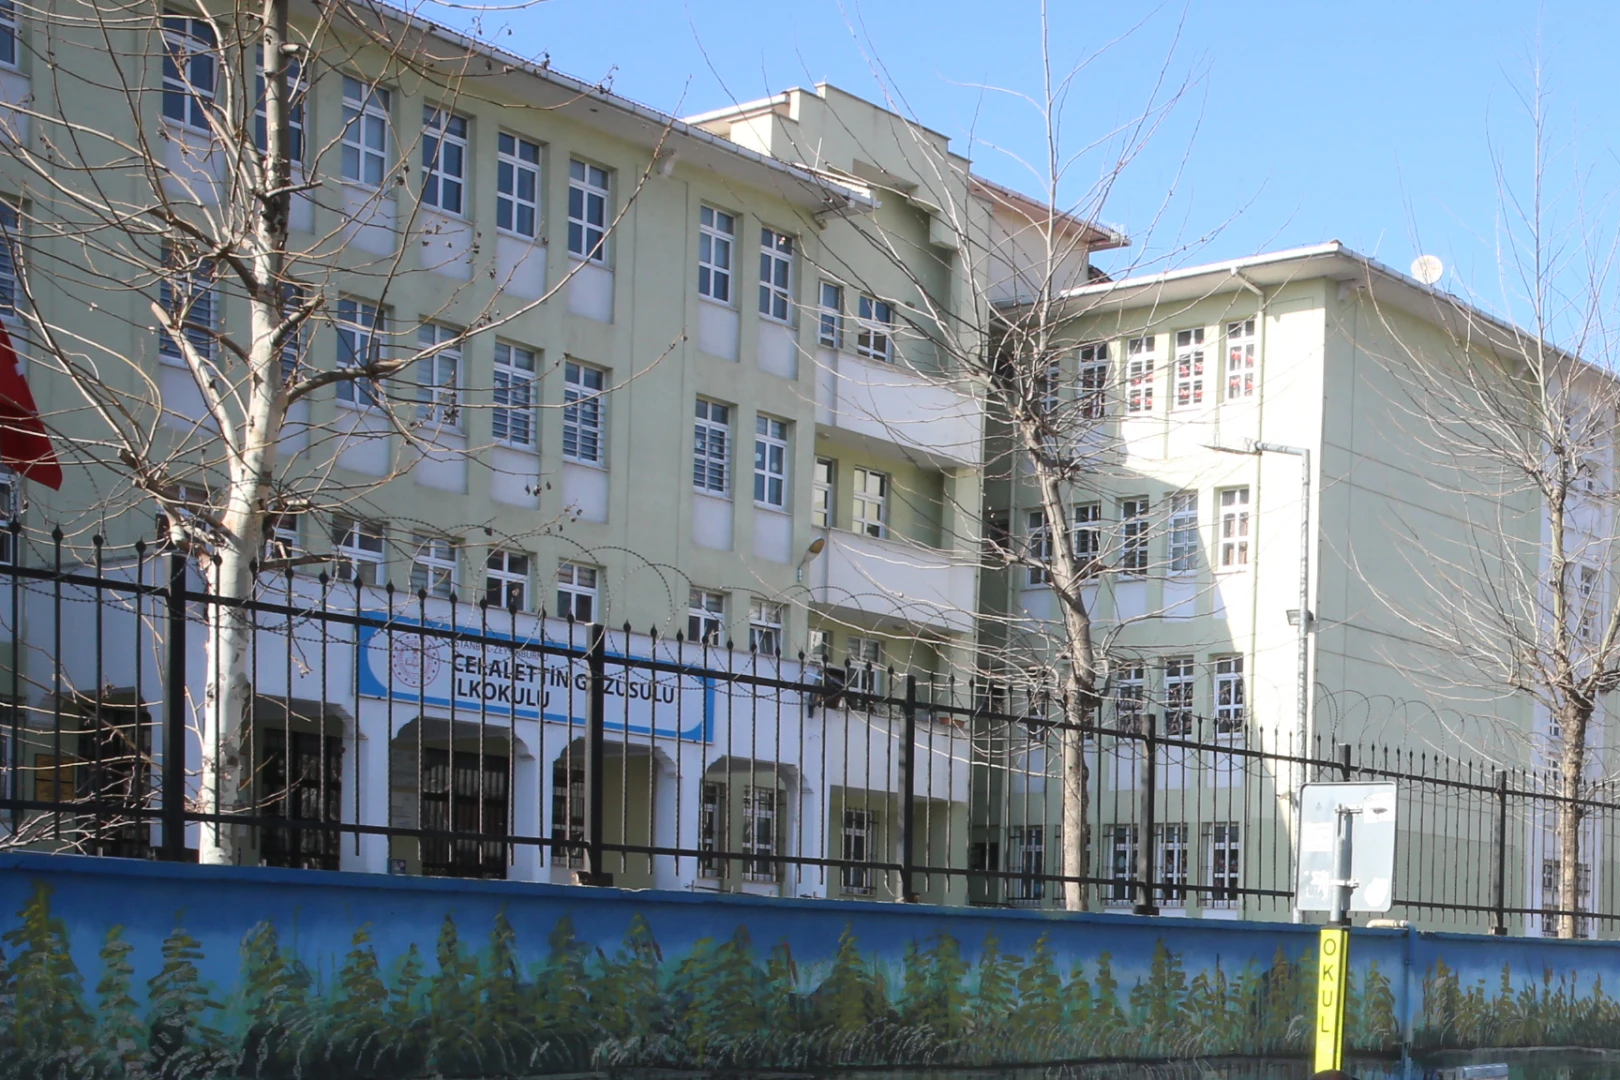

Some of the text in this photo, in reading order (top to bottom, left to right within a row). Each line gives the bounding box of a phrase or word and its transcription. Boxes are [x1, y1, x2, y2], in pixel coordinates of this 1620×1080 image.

[455, 677, 550, 708] LKOKULU
[574, 673, 675, 704] GZÜSULU
[1321, 938, 1336, 1032] OKUL
